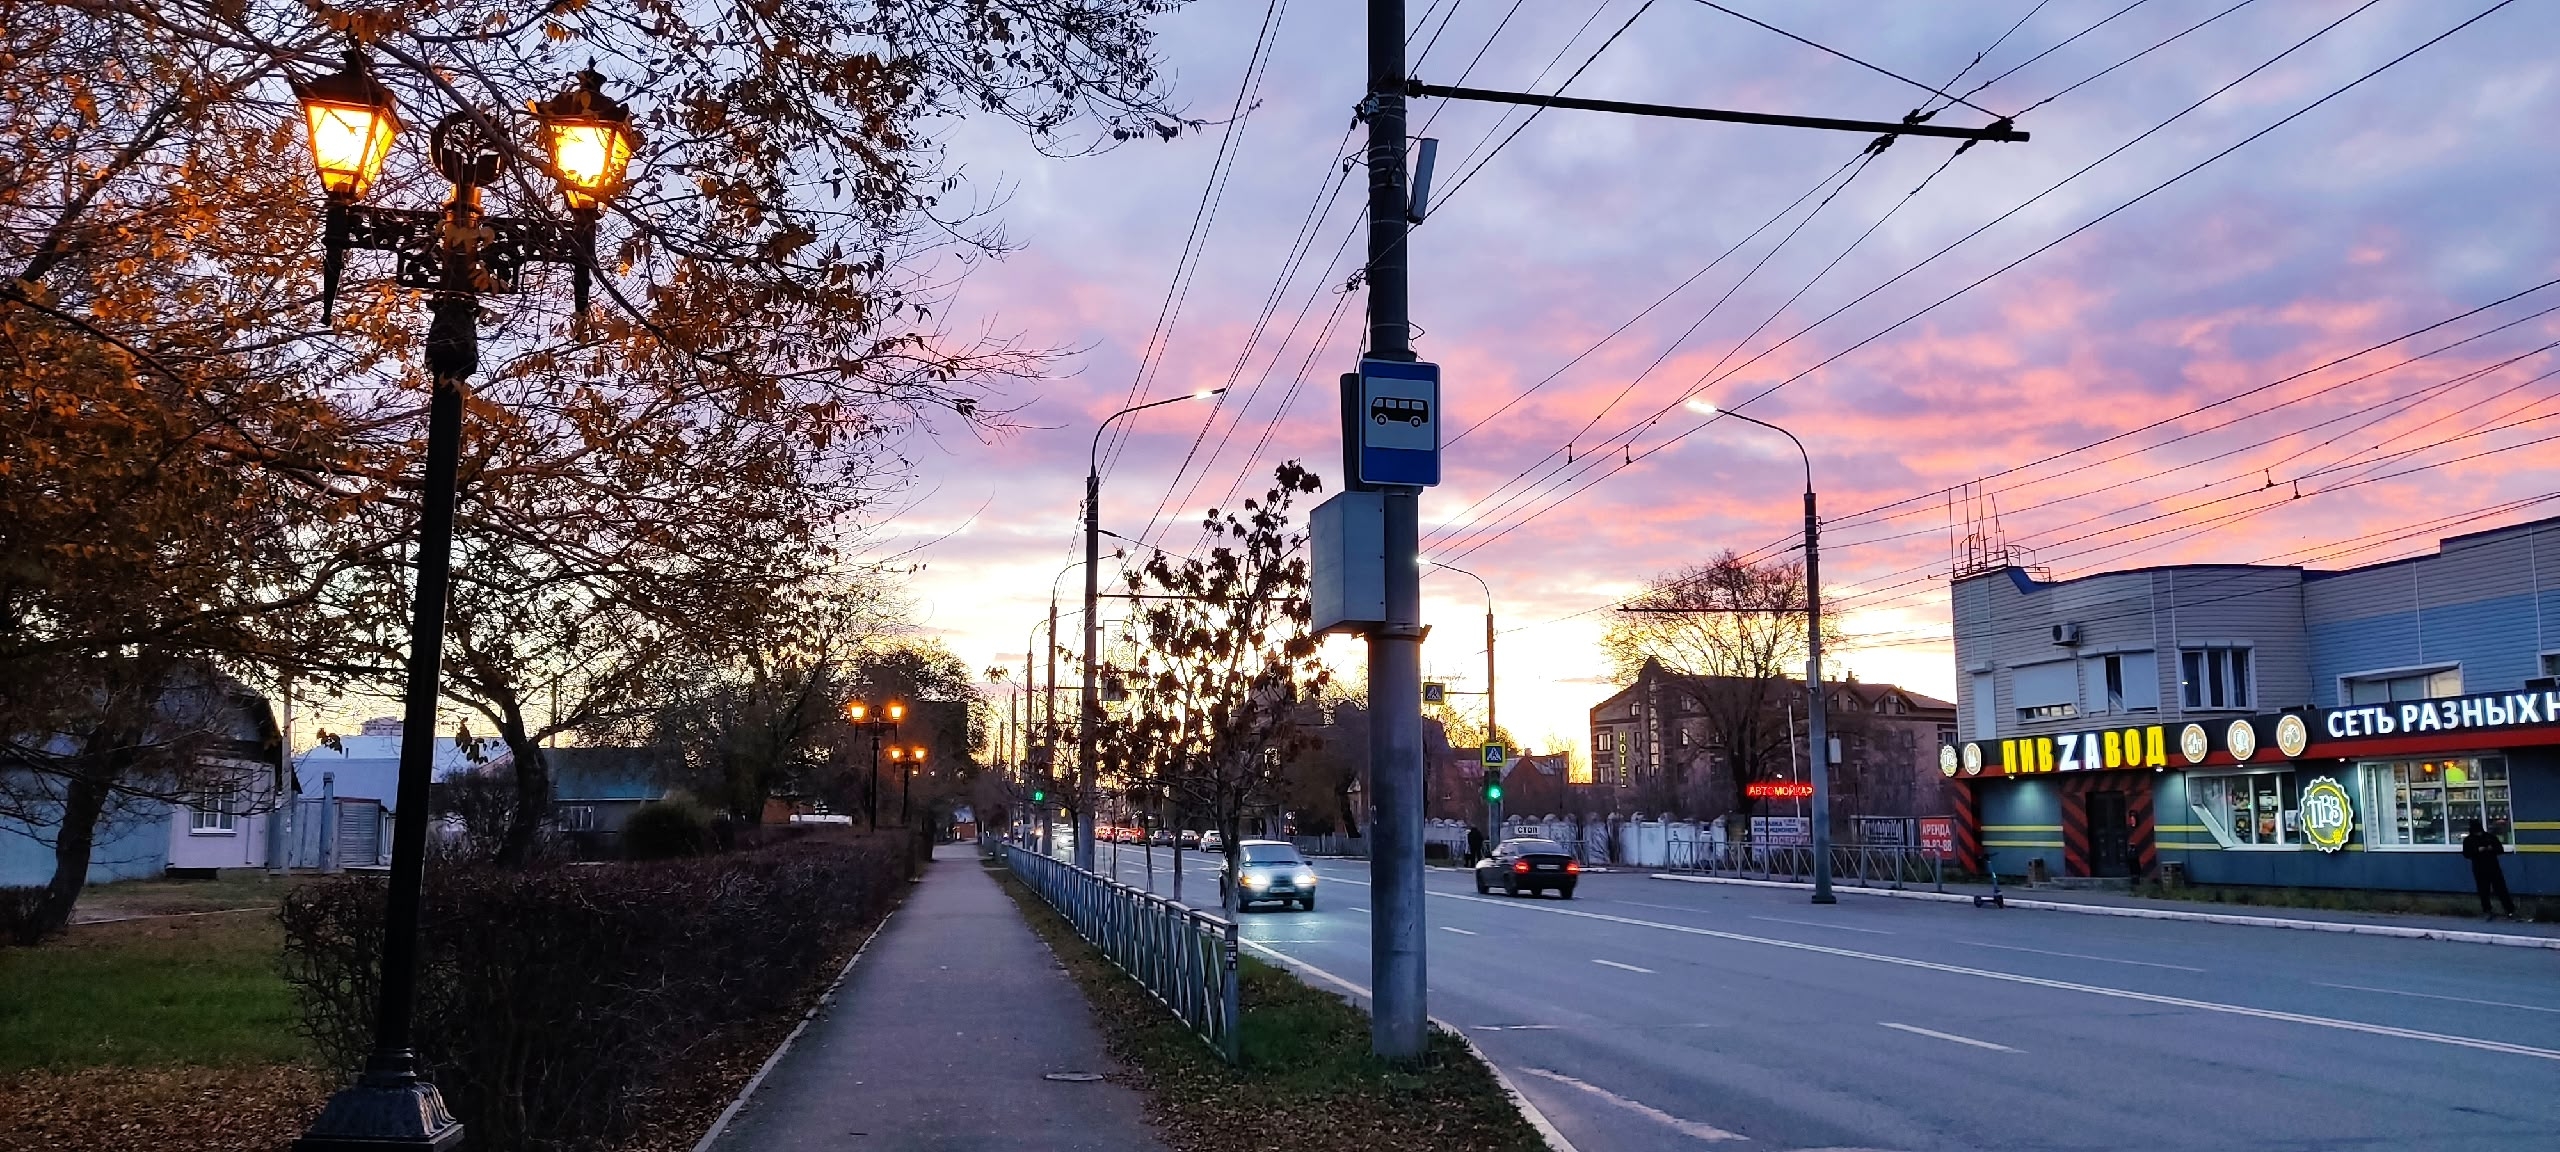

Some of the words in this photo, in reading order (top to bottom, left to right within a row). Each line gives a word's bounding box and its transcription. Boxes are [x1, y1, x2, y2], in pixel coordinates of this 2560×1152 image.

[2328, 707, 2395, 738] СЕТЬ
[2401, 694, 2543, 732] РАЗНЫХ
[1517, 826, 1538, 834] СТОП
[1922, 824, 1951, 837] АРЕНДА
